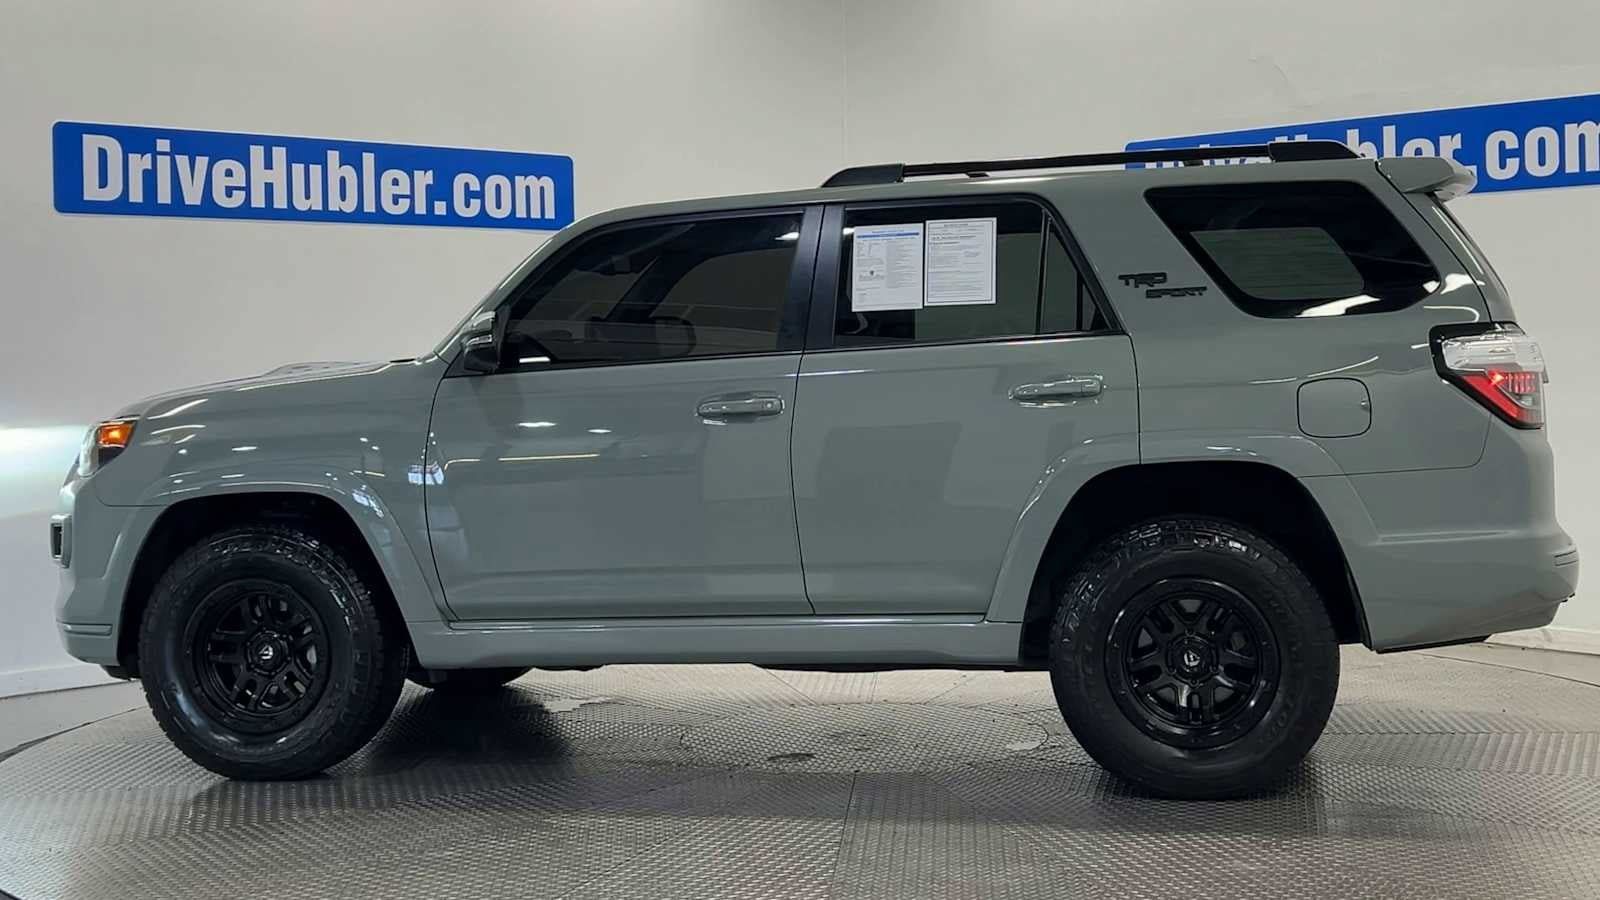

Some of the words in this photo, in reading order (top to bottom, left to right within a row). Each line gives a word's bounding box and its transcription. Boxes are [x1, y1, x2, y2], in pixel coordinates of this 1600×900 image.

[81, 133, 556, 220] DriveHubler.com
[1118, 272, 1167, 288] TRD
[1145, 286, 1207, 299] SPORT
